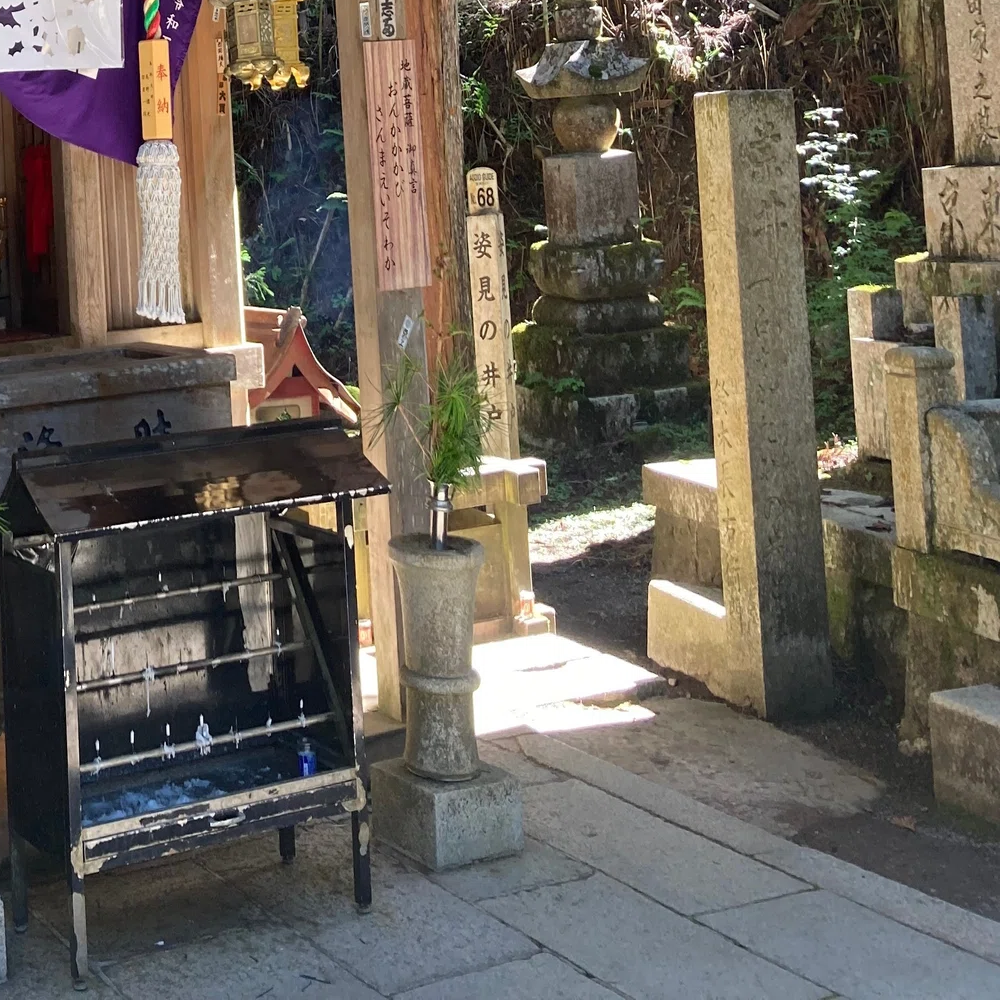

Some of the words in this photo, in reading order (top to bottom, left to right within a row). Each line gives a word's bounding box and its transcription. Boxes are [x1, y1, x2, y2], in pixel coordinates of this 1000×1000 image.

[156, 64, 169, 114] 奉納
[400, 58, 415, 128] 地蔵菩薩
[388, 83, 405, 199] おんかかかび
[405, 143, 418, 195] 御真言
[375, 105, 397, 272] さんまえいそわか
[477, 187, 494, 206] 68
[473, 231, 502, 433] 姿見の井戸
